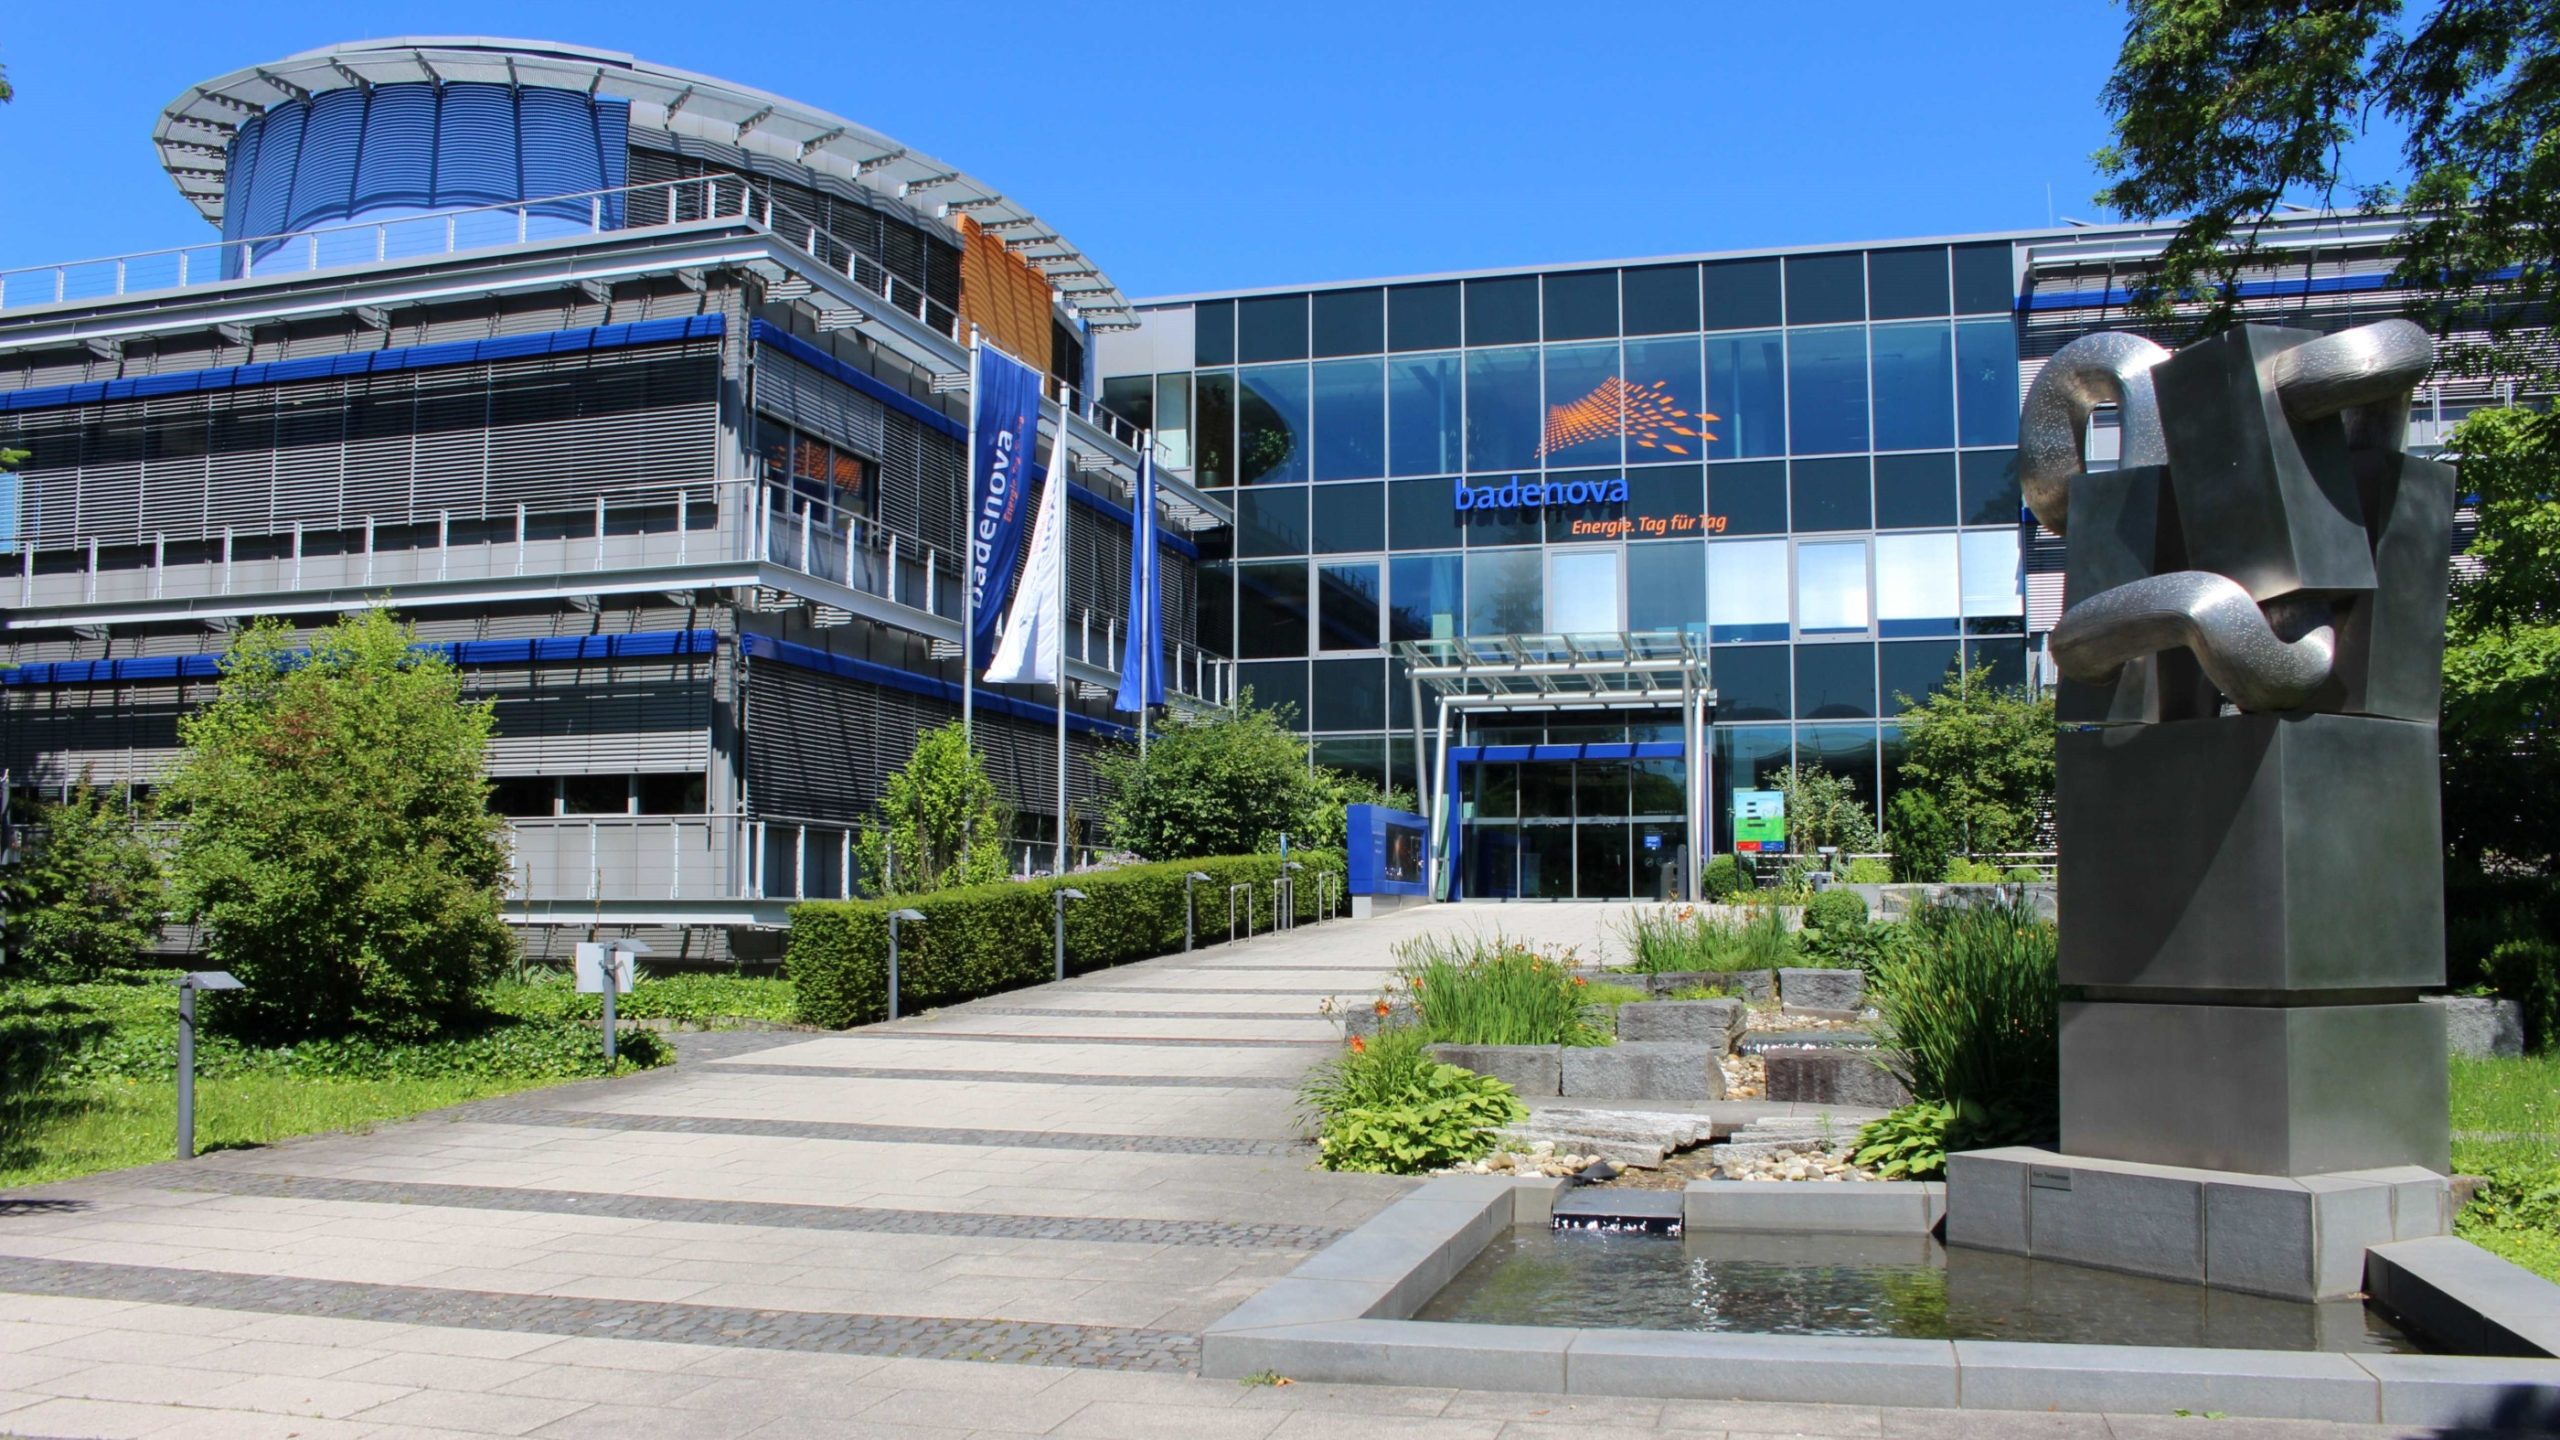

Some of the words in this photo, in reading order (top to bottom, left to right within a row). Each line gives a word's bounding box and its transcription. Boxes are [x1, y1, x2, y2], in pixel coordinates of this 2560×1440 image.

[1454, 475, 1629, 511] badenova
[1572, 517, 1635, 538] Energie.
[1639, 516, 1666, 535] Tag
[1671, 514, 1697, 531] für
[1700, 513, 1727, 532] Tag
